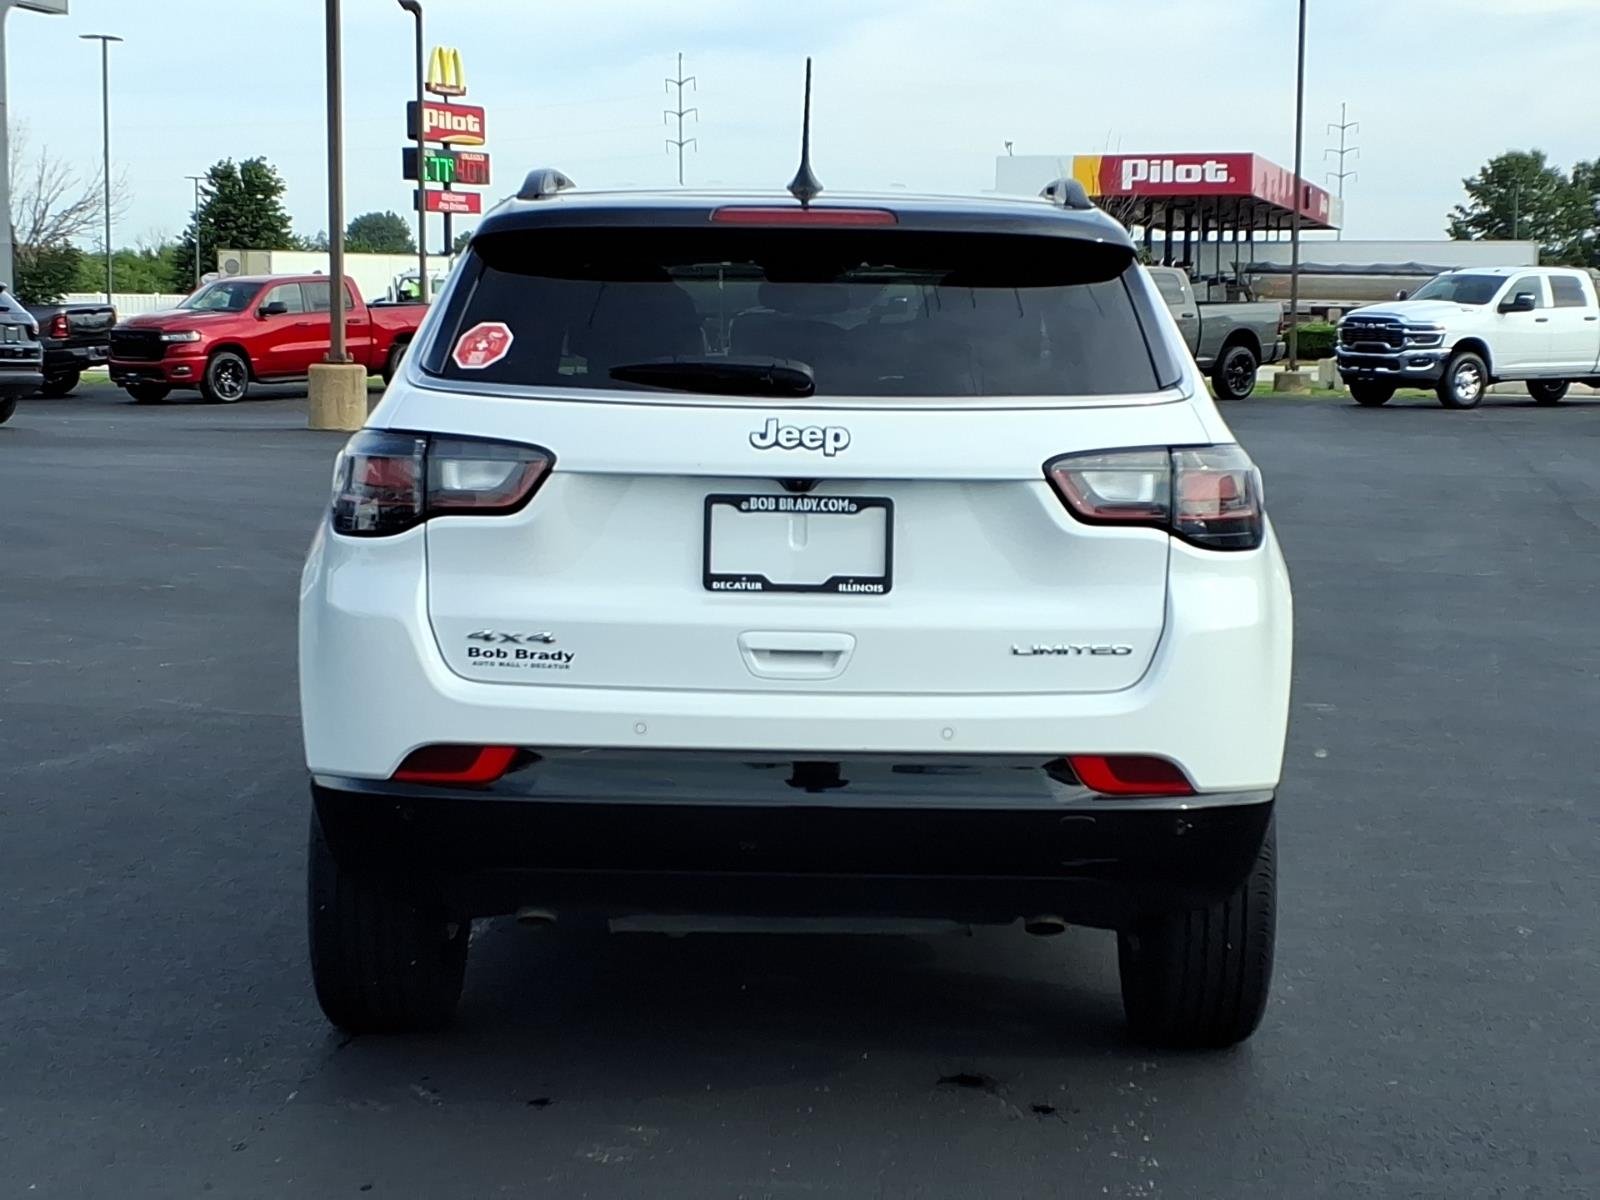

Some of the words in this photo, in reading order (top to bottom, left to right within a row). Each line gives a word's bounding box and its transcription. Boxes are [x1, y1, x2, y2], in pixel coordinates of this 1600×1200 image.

[423, 107, 481, 133] Pilot
[1121, 159, 1229, 190] Pilot
[750, 418, 851, 457] Jeep
[750, 497, 776, 511] BOB
[779, 498, 849, 512] BRADY.COM
[712, 581, 762, 590] DECATUR
[838, 583, 884, 593] ILLINOIS
[468, 647, 508, 659] Bob
[515, 649, 575, 663] Brady
[1010, 644, 1133, 656] LIMITED
